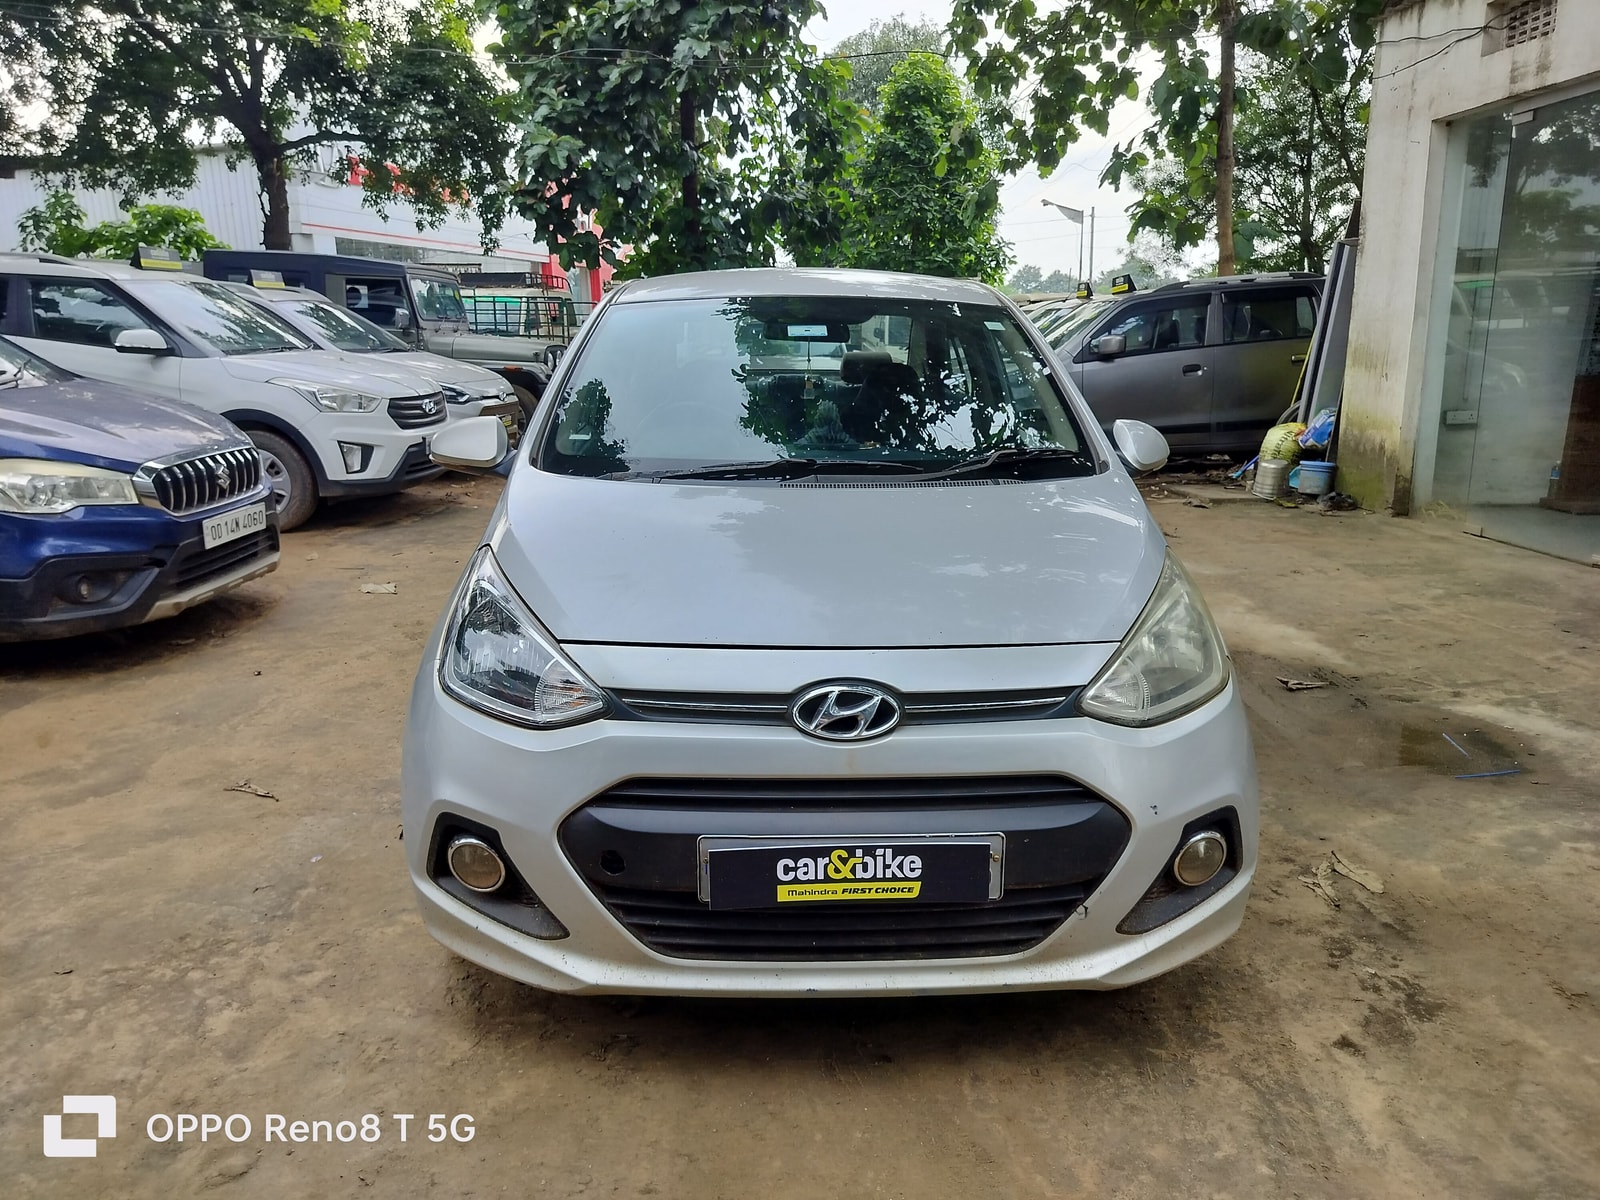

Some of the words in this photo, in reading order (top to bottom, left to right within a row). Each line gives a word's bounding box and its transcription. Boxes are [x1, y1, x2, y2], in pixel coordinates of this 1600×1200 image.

[210, 523, 223, 540] OD
[242, 510, 264, 529] 4060
[777, 848, 922, 881] car&bike
[787, 888, 838, 897] Mahindra
[841, 887, 874, 895] FIRST
[874, 886, 915, 894] CHOICE
